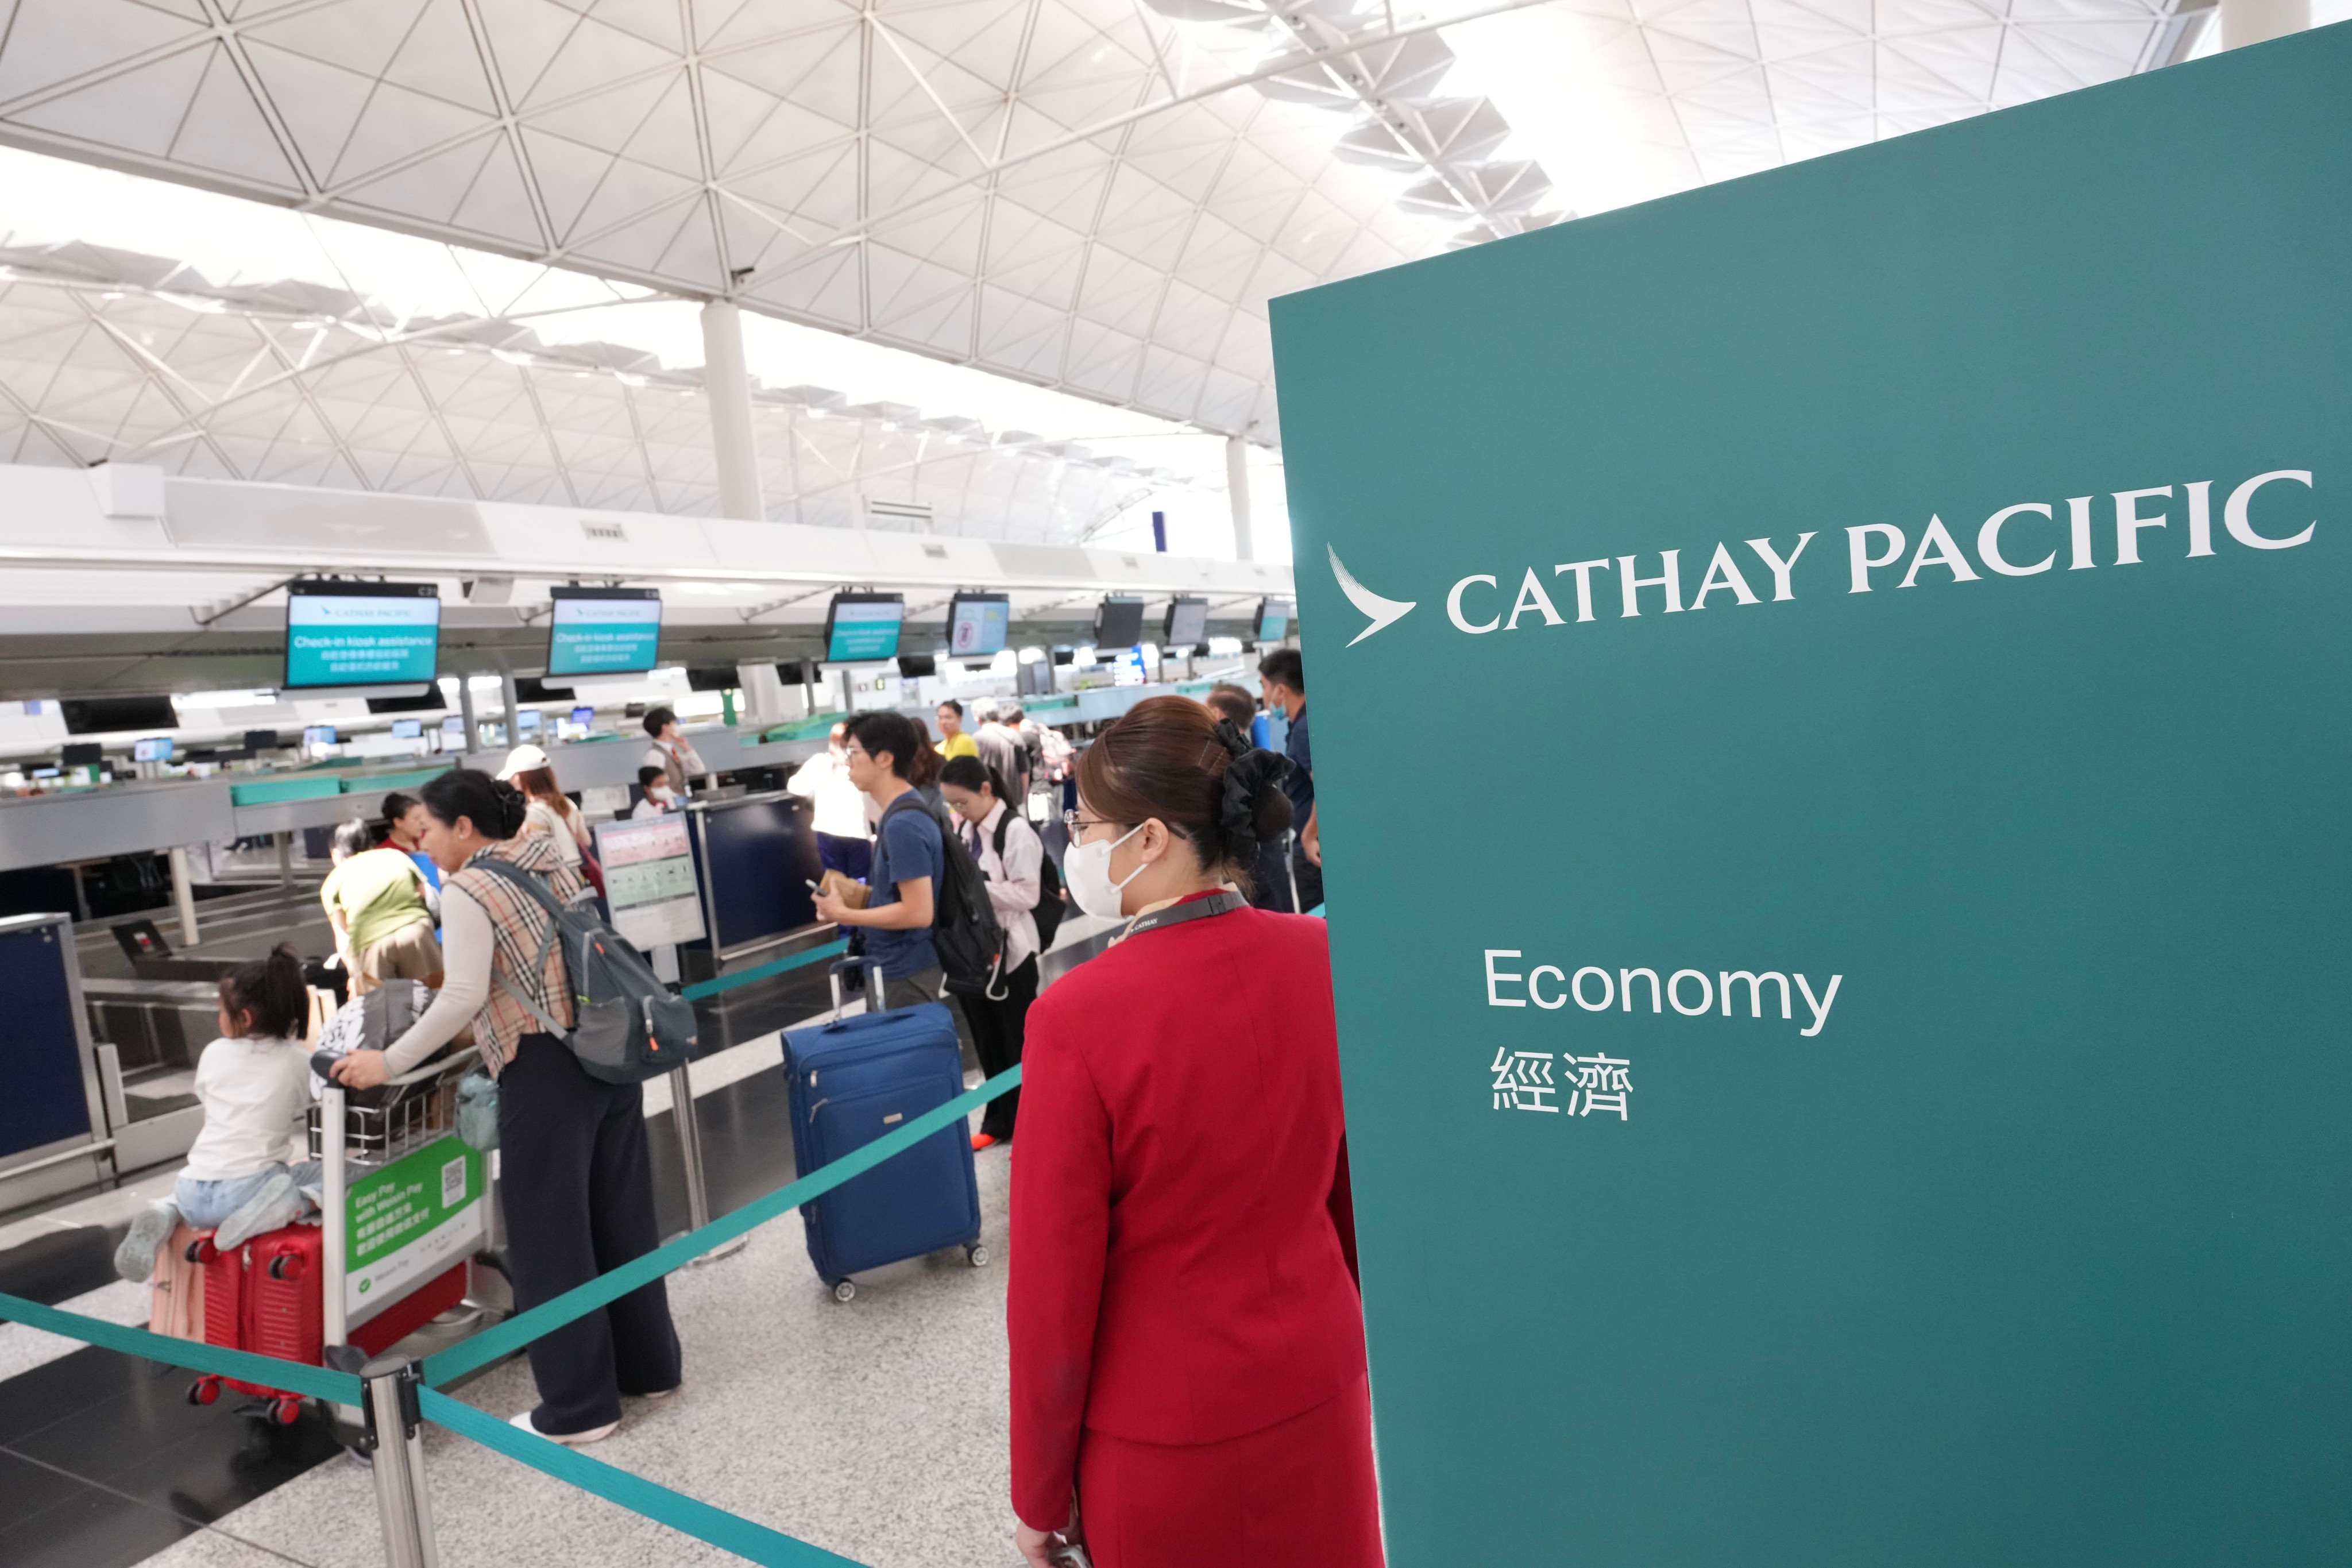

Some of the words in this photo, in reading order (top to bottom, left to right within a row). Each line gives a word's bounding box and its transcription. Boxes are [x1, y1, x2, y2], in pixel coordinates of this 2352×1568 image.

[1447, 531, 1818, 634] CATHAY
[1844, 469, 2316, 593] PACIFIC
[293, 636, 345, 648] Check-in
[346, 635, 376, 647] kiosk
[377, 636, 432, 646] assistance
[1134, 918, 1158, 930] CATHAY
[1484, 949, 1843, 1037] Economy
[1490, 1046, 1633, 1121] 經濟
[356, 1192, 377, 1208] Easy
[377, 1182, 396, 1196] Pay
[356, 1206, 376, 1223] with
[376, 1191, 407, 1211] Weixin
[406, 1183, 423, 1196] Pay
